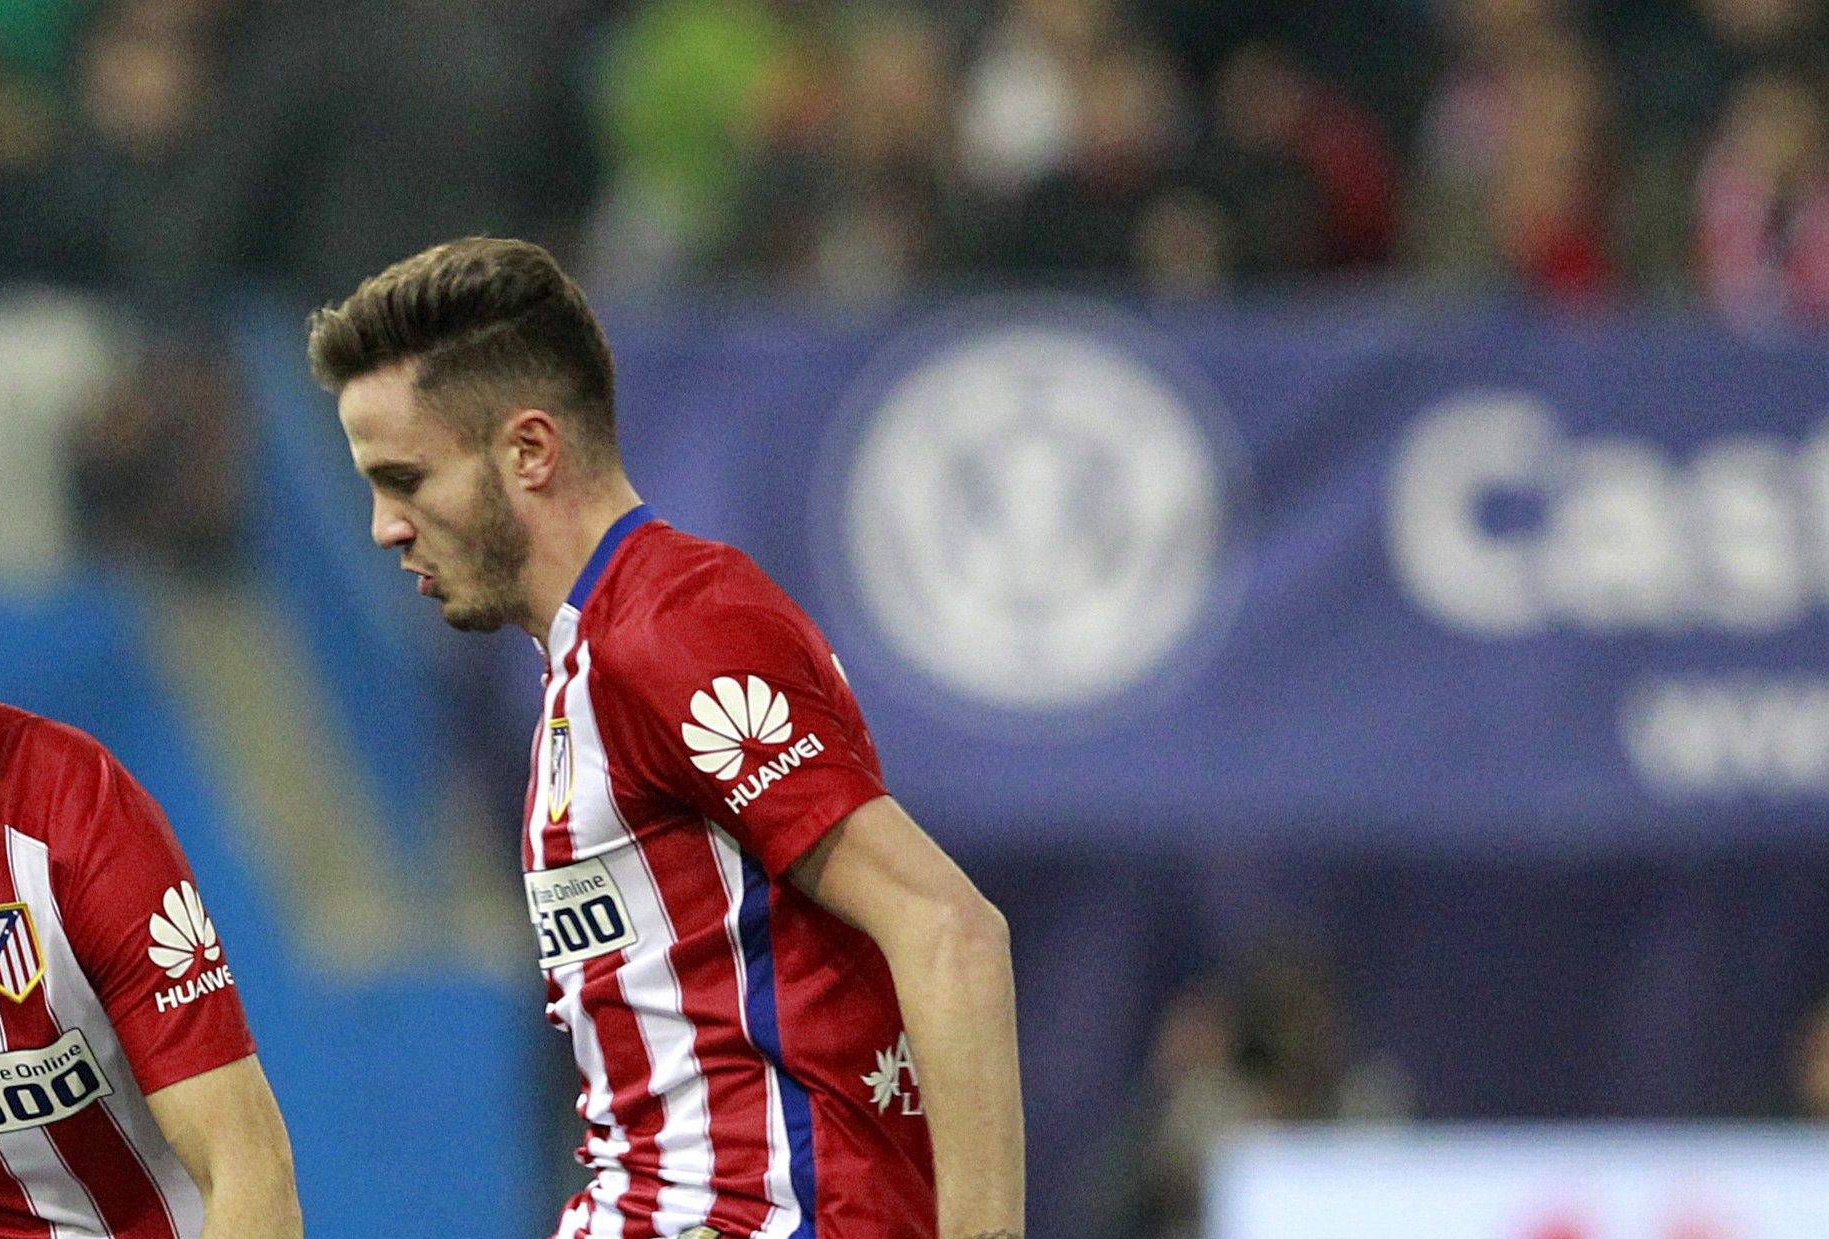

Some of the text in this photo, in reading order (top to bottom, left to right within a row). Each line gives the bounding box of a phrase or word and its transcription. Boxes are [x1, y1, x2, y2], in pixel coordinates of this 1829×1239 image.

[724, 732, 825, 814] HUAWEI
[154, 964, 235, 1013] HUAWE
[15, 1043, 82, 1080] Online
